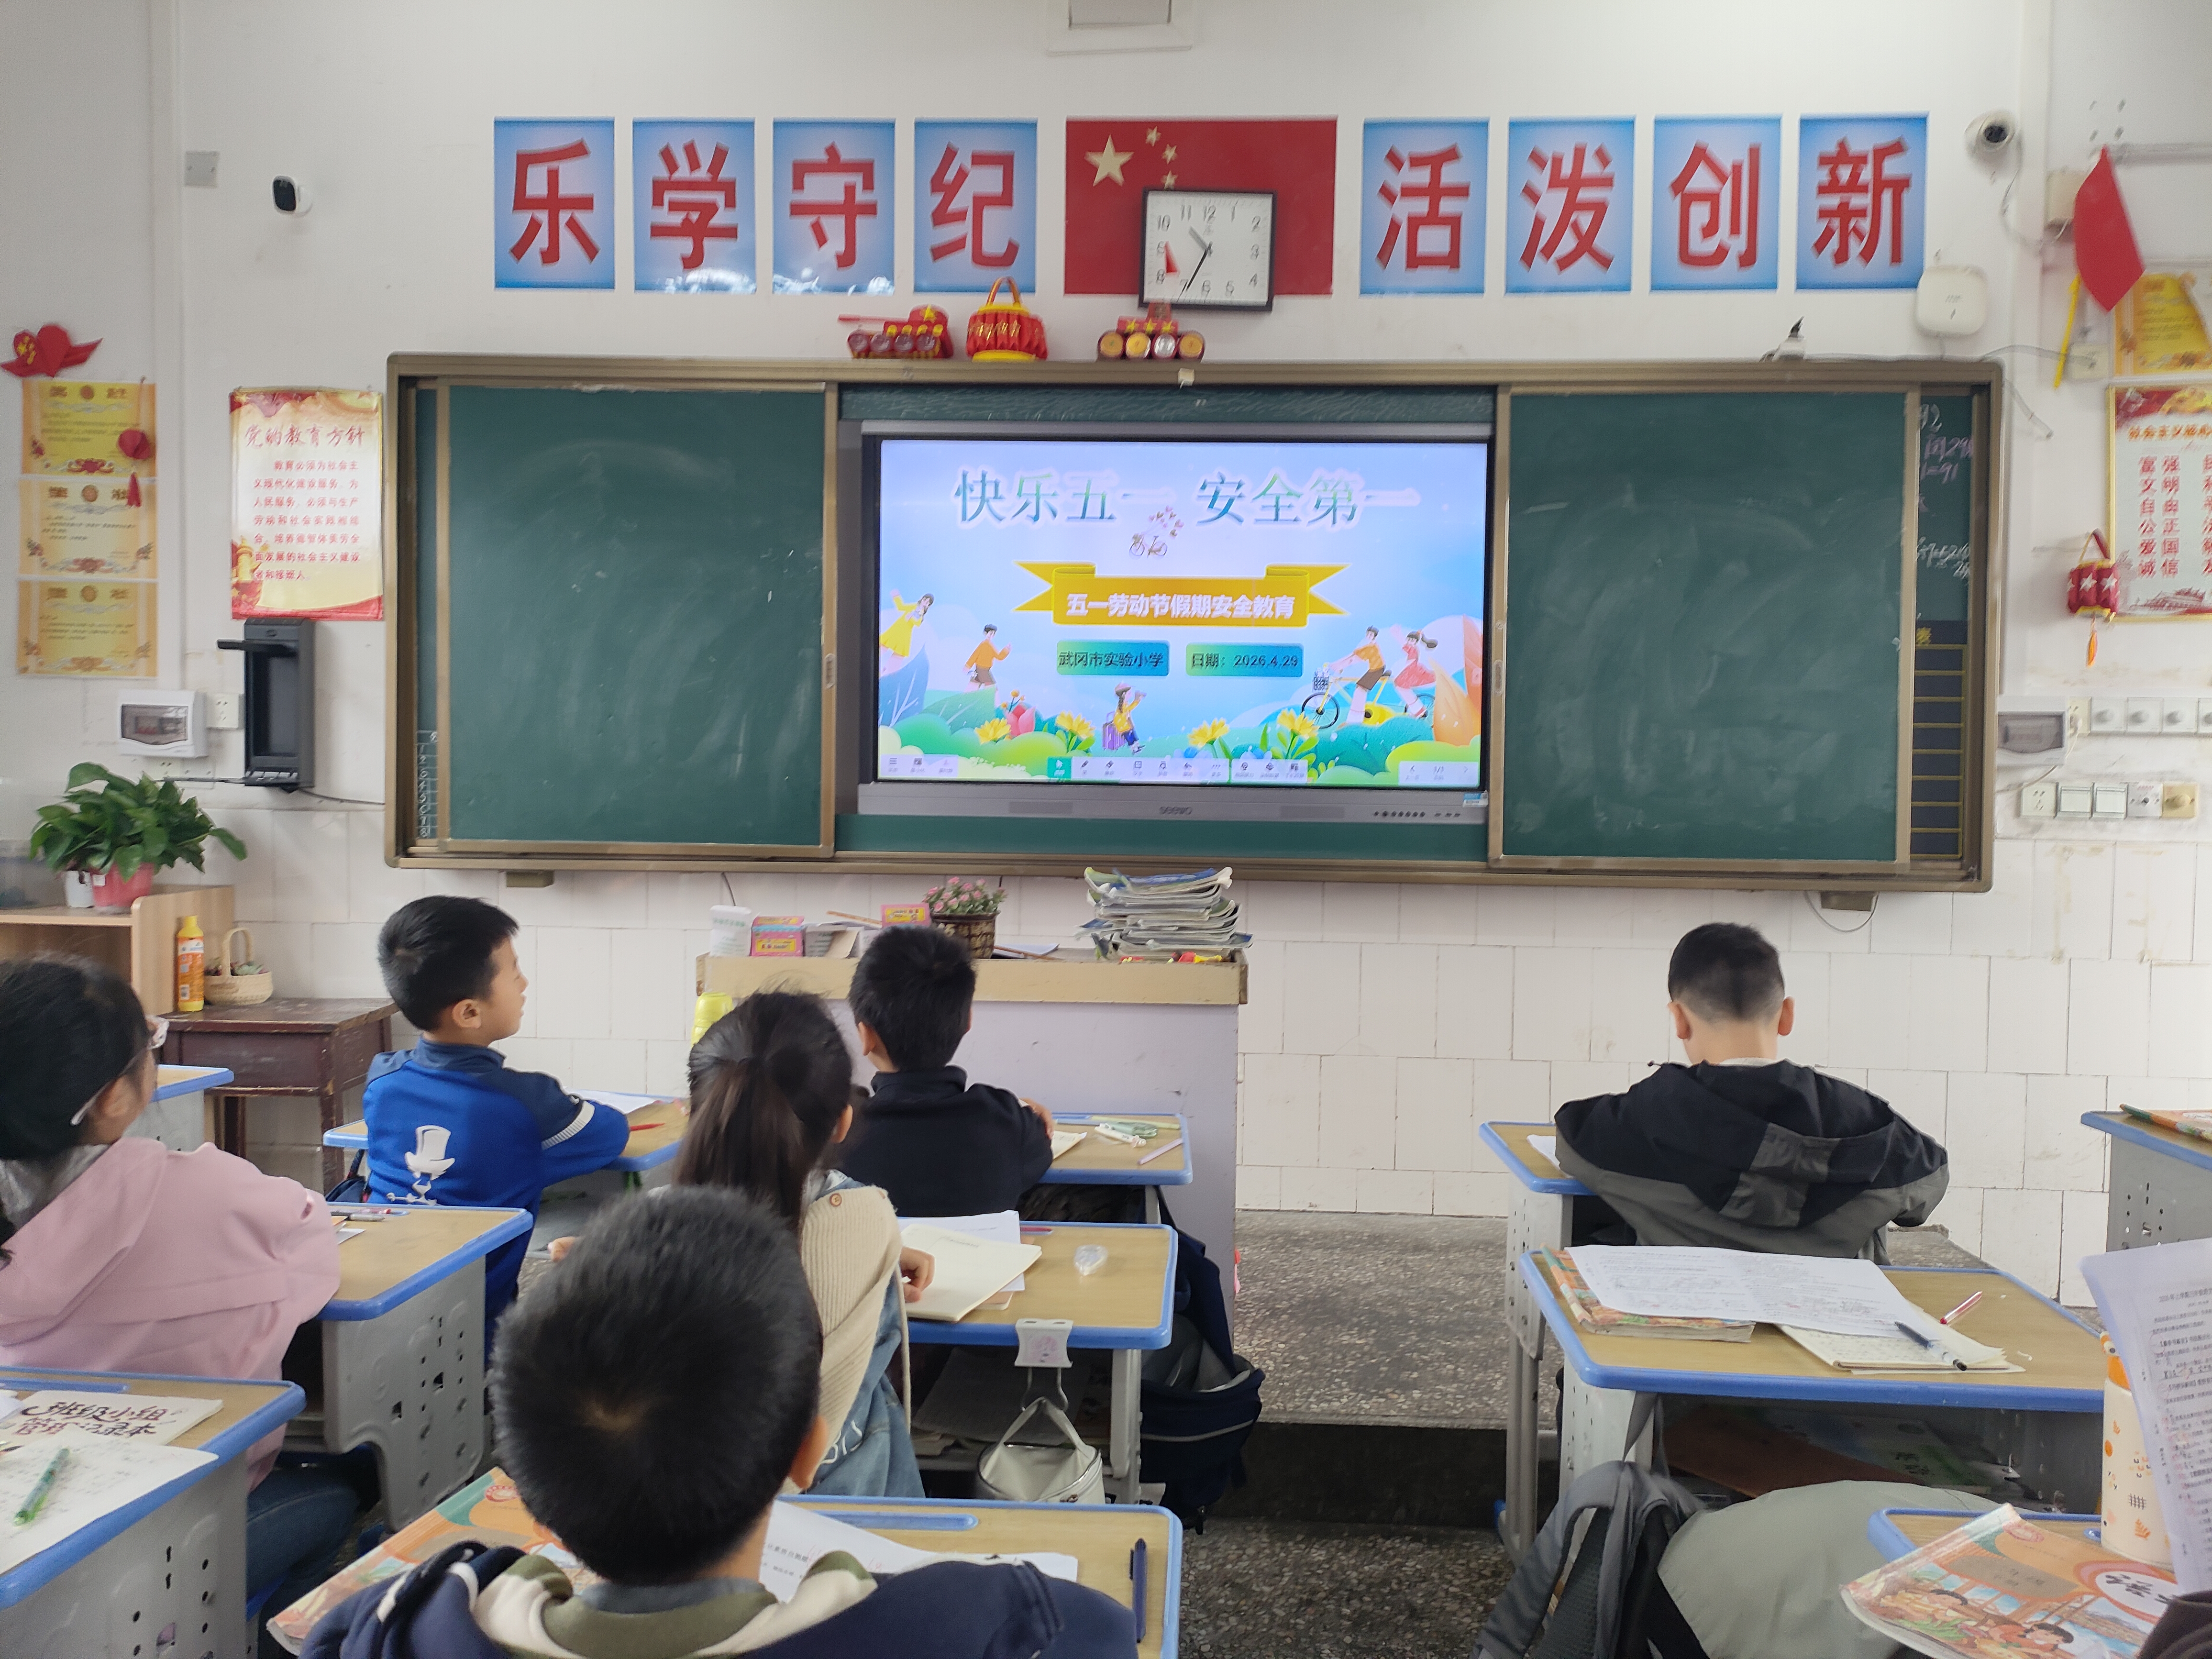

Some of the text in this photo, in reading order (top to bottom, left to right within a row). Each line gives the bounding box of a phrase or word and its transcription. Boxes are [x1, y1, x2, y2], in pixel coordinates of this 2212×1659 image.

[509, 138, 1020, 269] 乐学守纪
[1181, 205, 1192, 221] 11
[1375, 135, 1911, 273] 活泼创新
[1157, 214, 1171, 232] 10
[1203, 205, 1216, 222] 12
[1252, 216, 1261, 232] 2
[1250, 243, 1260, 260] 3
[245, 424, 365, 447] 党的教育方针
[2138, 455, 2180, 474] 富强
[2138, 476, 2180, 496] 文明
[953, 470, 1417, 527] 快乐五一 安全第一
[2138, 497, 2180, 517] 自由
[2138, 518, 2180, 536] 公正
[2138, 539, 2180, 557] 爱国
[2138, 558, 2180, 577] 诚信
[1067, 593, 1294, 619] 五一劳动节假期安全教育
[1058, 651, 1164, 667] 武冈市实验小学
